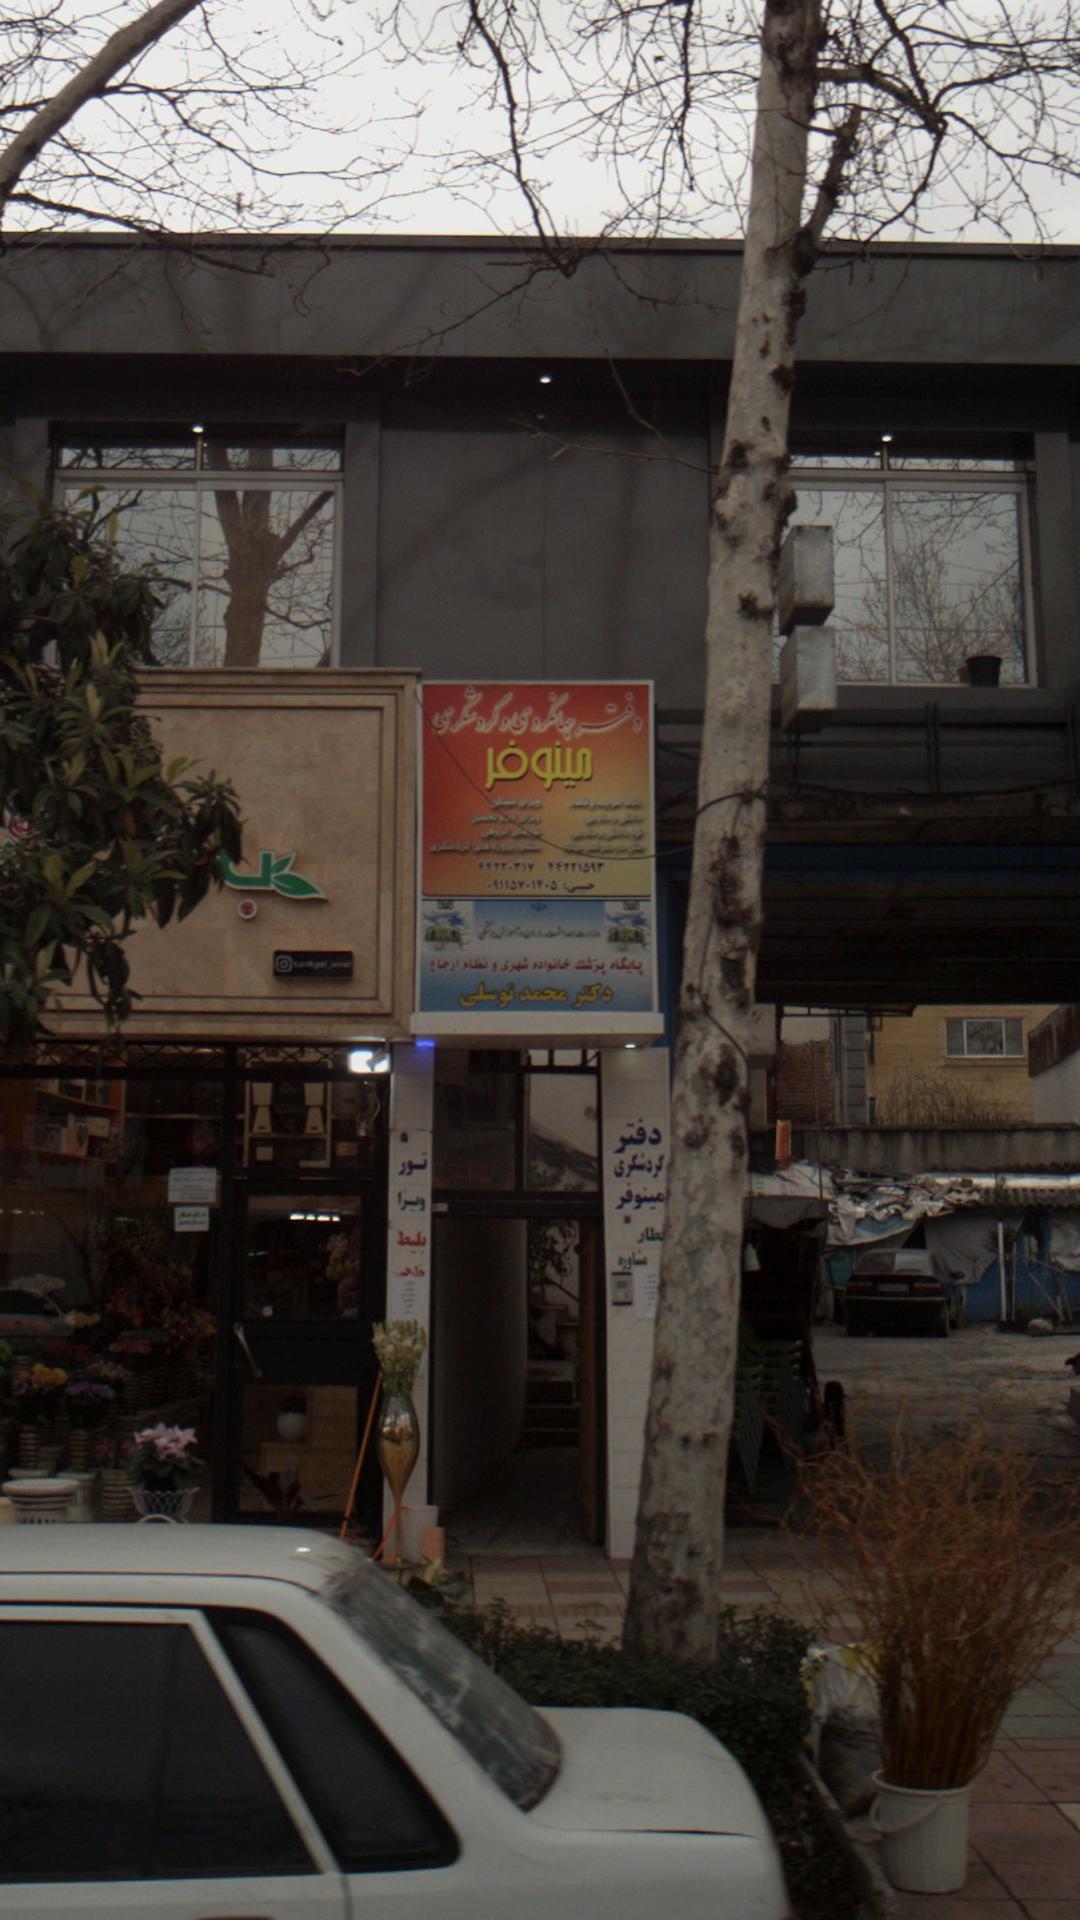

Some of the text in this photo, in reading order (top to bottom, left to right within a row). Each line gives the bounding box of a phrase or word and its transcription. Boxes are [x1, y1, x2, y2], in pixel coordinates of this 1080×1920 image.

[575, 692, 643, 738] دفتر
[485, 740, 593, 790] مینوفر
[430, 958, 460, 973] ارجاع
[463, 956, 489, 970] نظام
[491, 963, 498, 973] و
[500, 956, 529, 973] شهری
[532, 957, 570, 971] خانواده
[609, 956, 645, 976] پایگاه
[460, 981, 614, 1010] دکتر محمد توسلی
[613, 1117, 662, 1153] دفتر
[397, 1153, 428, 1175] تور
[614, 1182, 666, 1210] مینوفر
[396, 1230, 428, 1254] بلیط
